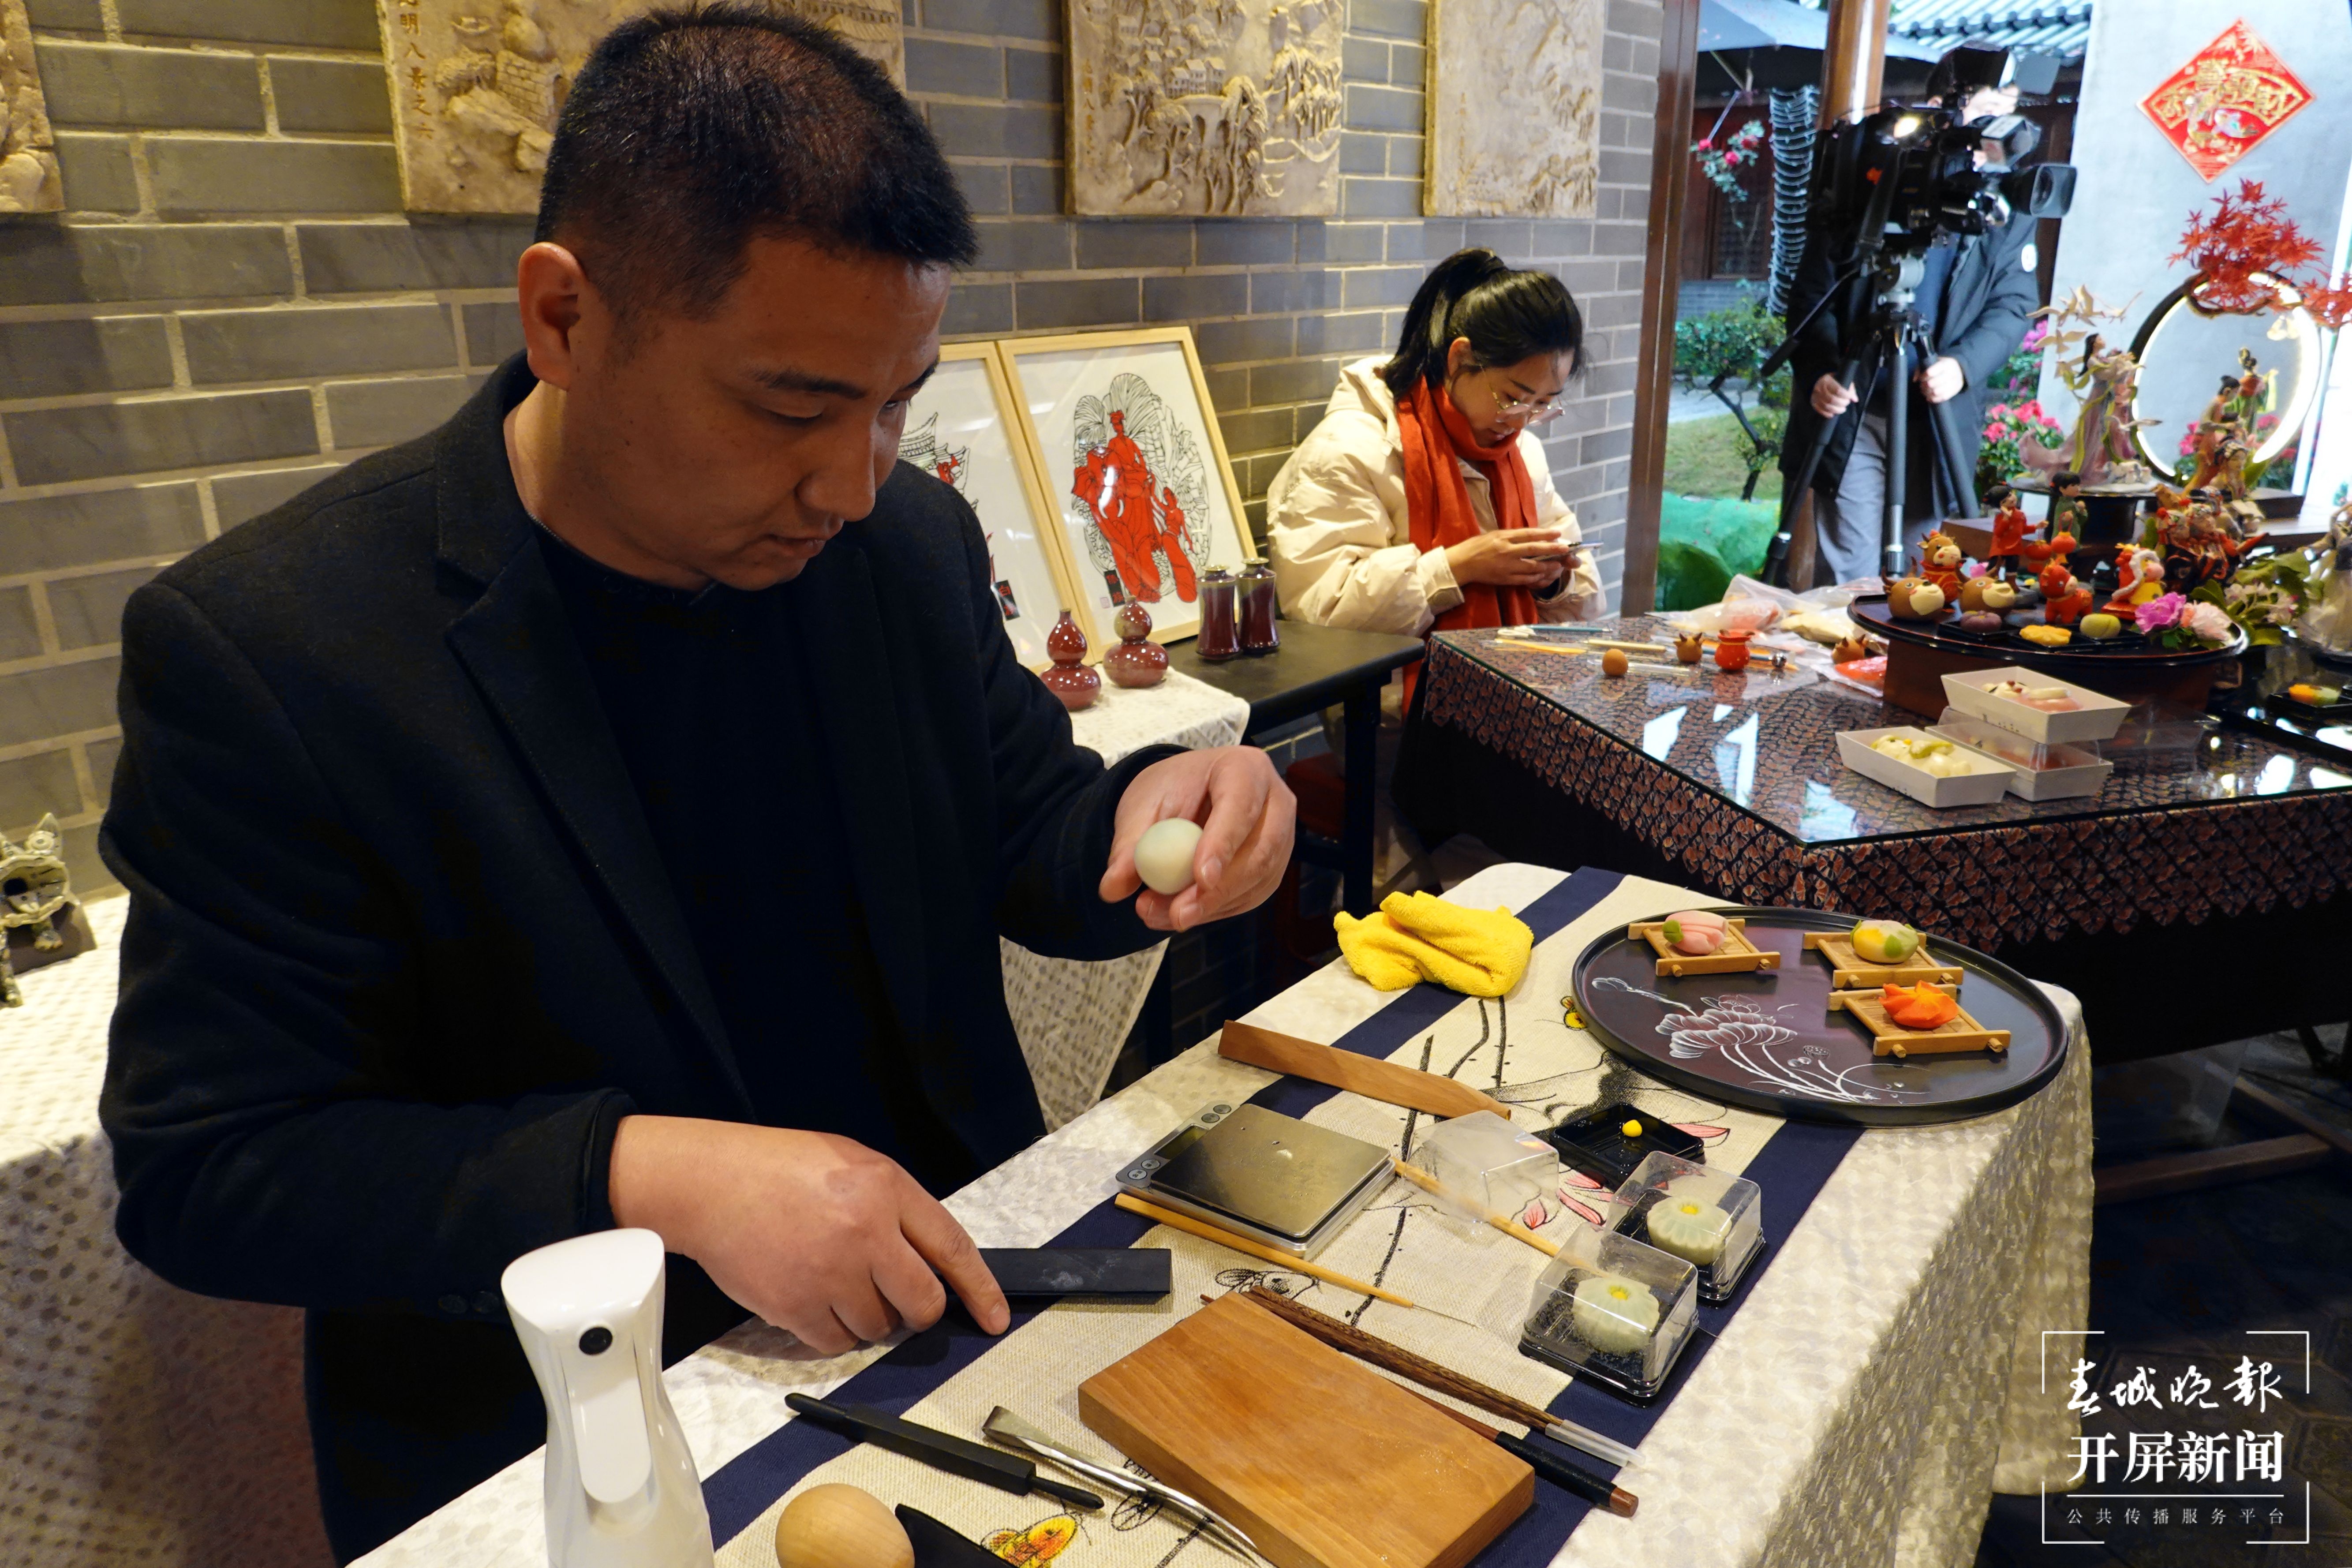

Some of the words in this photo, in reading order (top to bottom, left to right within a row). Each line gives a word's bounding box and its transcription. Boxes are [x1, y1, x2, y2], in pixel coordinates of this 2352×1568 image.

[398, 0, 435, 140] 明八景之六
